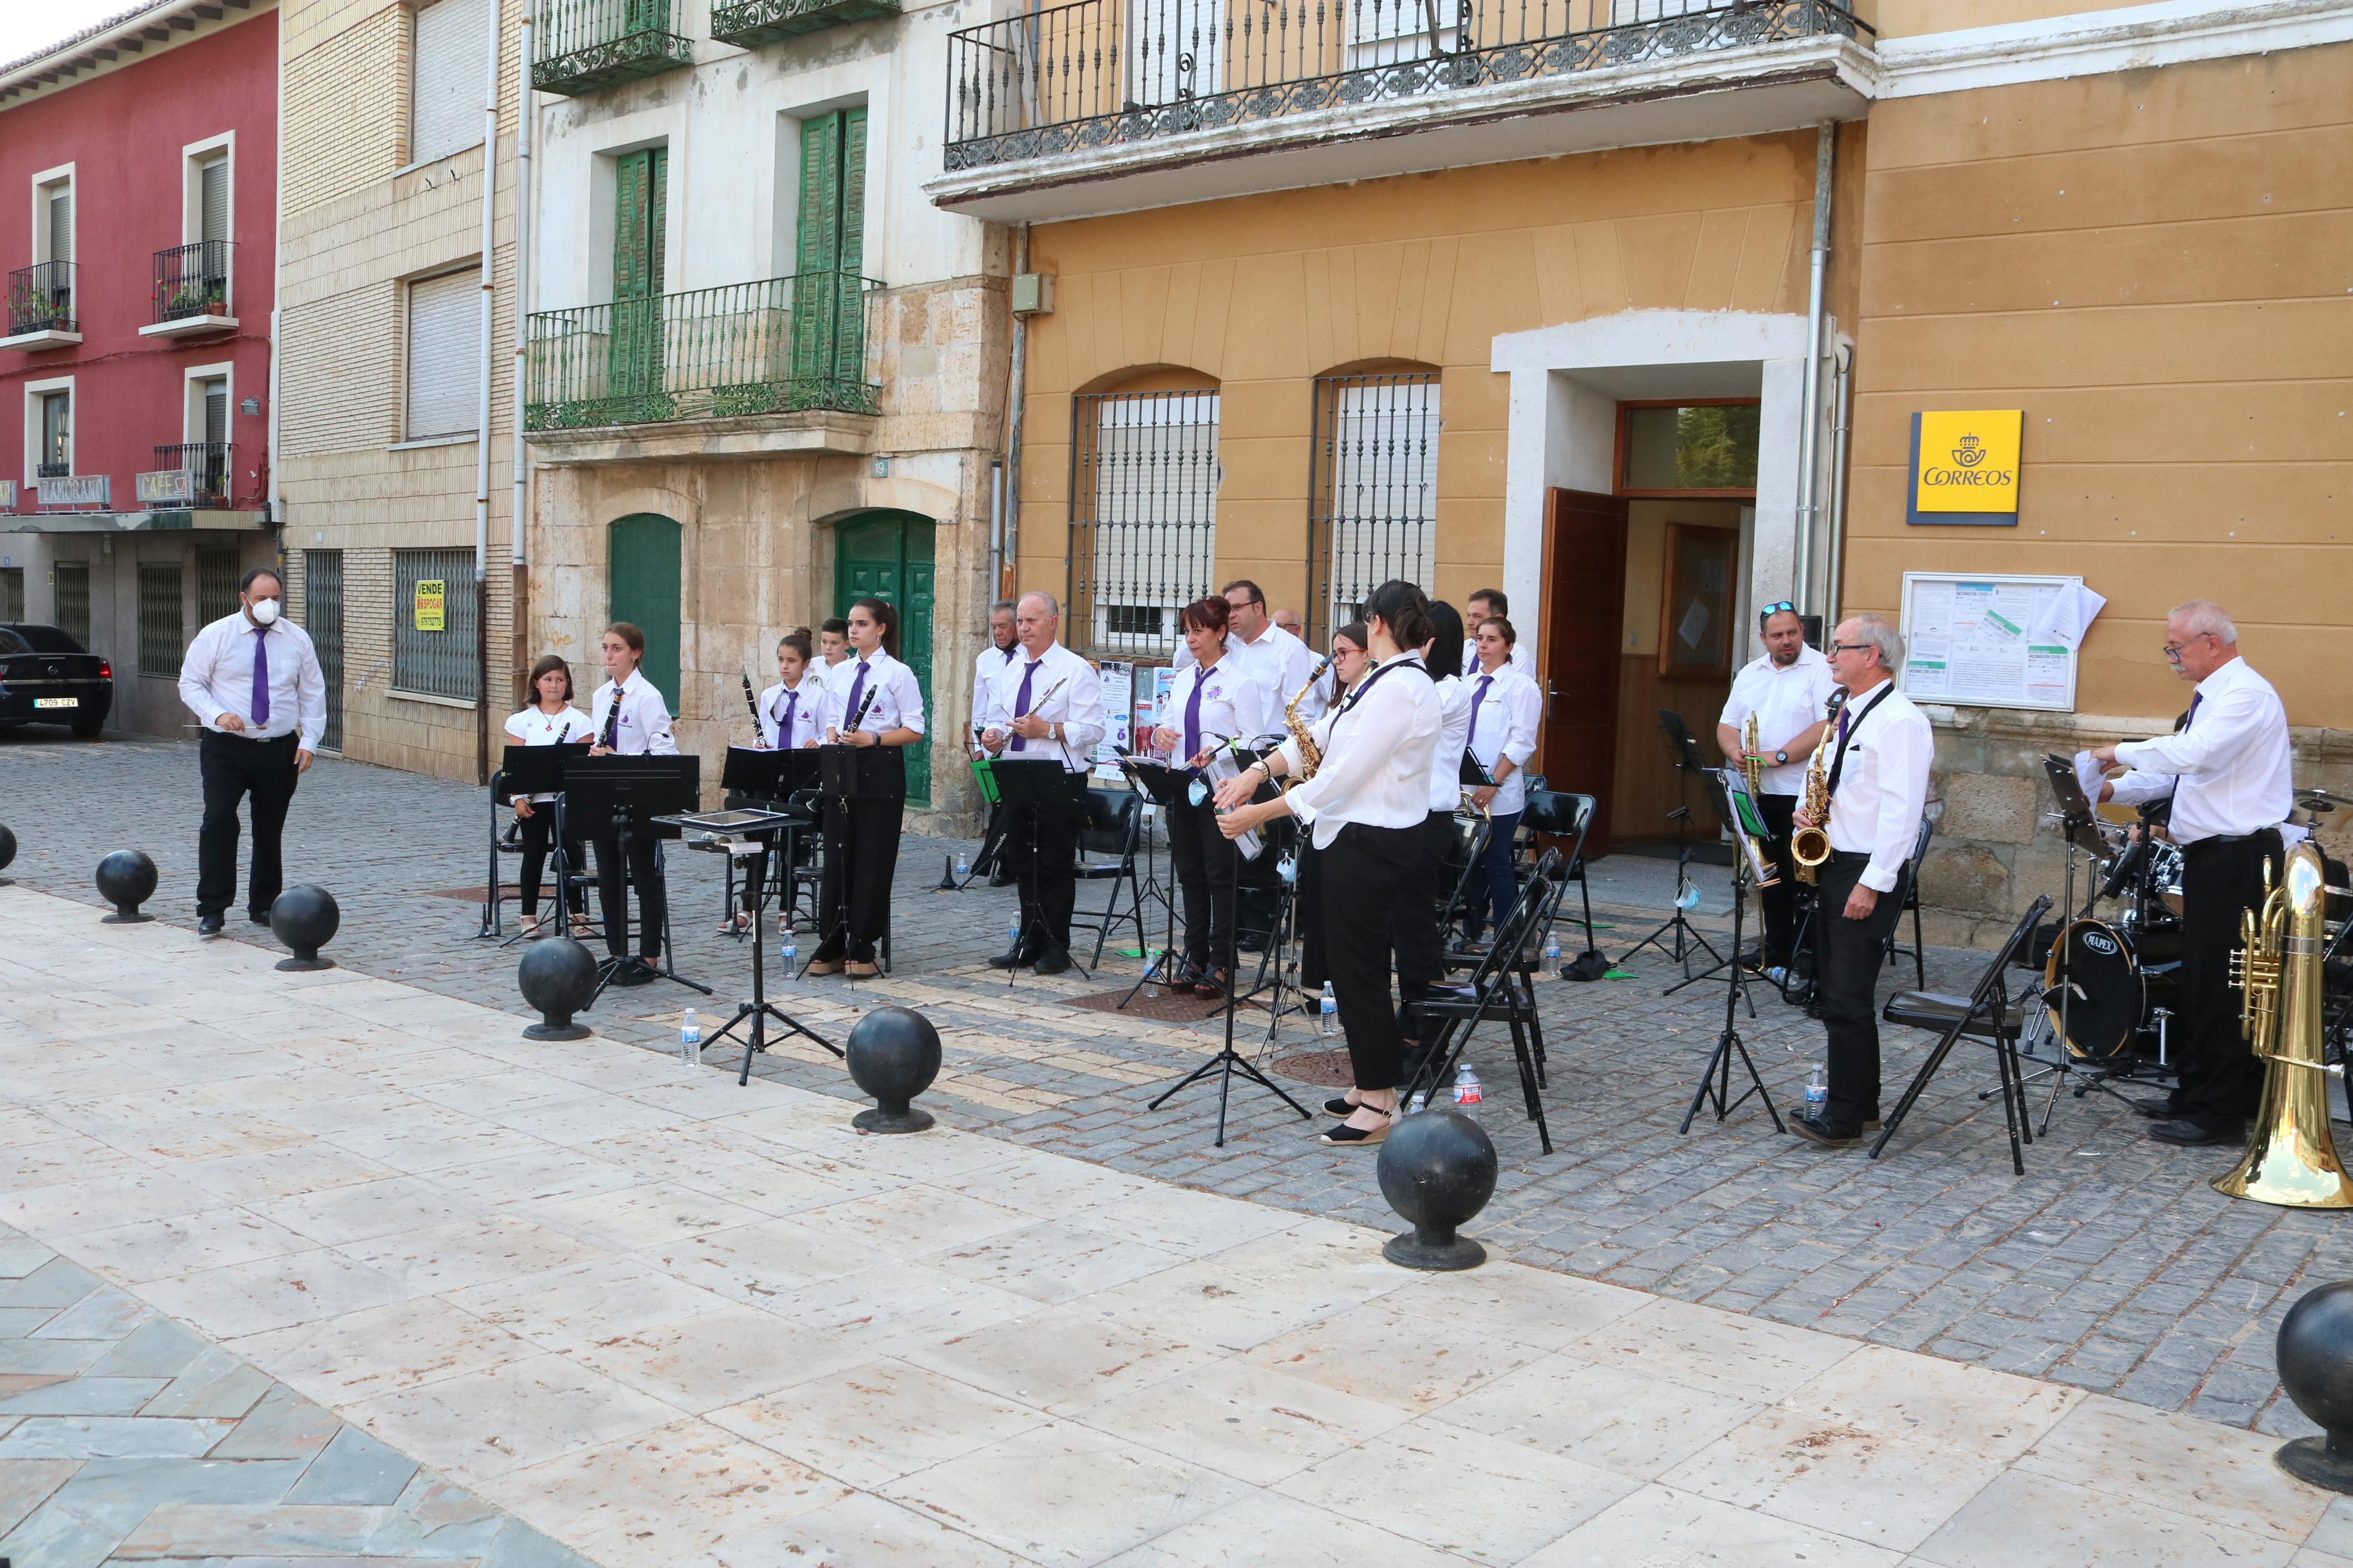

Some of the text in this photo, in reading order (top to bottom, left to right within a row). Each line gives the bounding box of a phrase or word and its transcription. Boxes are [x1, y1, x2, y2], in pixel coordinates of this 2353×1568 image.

[875, 461, 884, 474] 19
[1923, 467, 2012, 486] CORREOS
[42, 479, 104, 501] ZAMORANO
[417, 584, 442, 594] VENDE
[421, 617, 441, 626] 979752775
[2088, 935, 2113, 951] MAPEX
